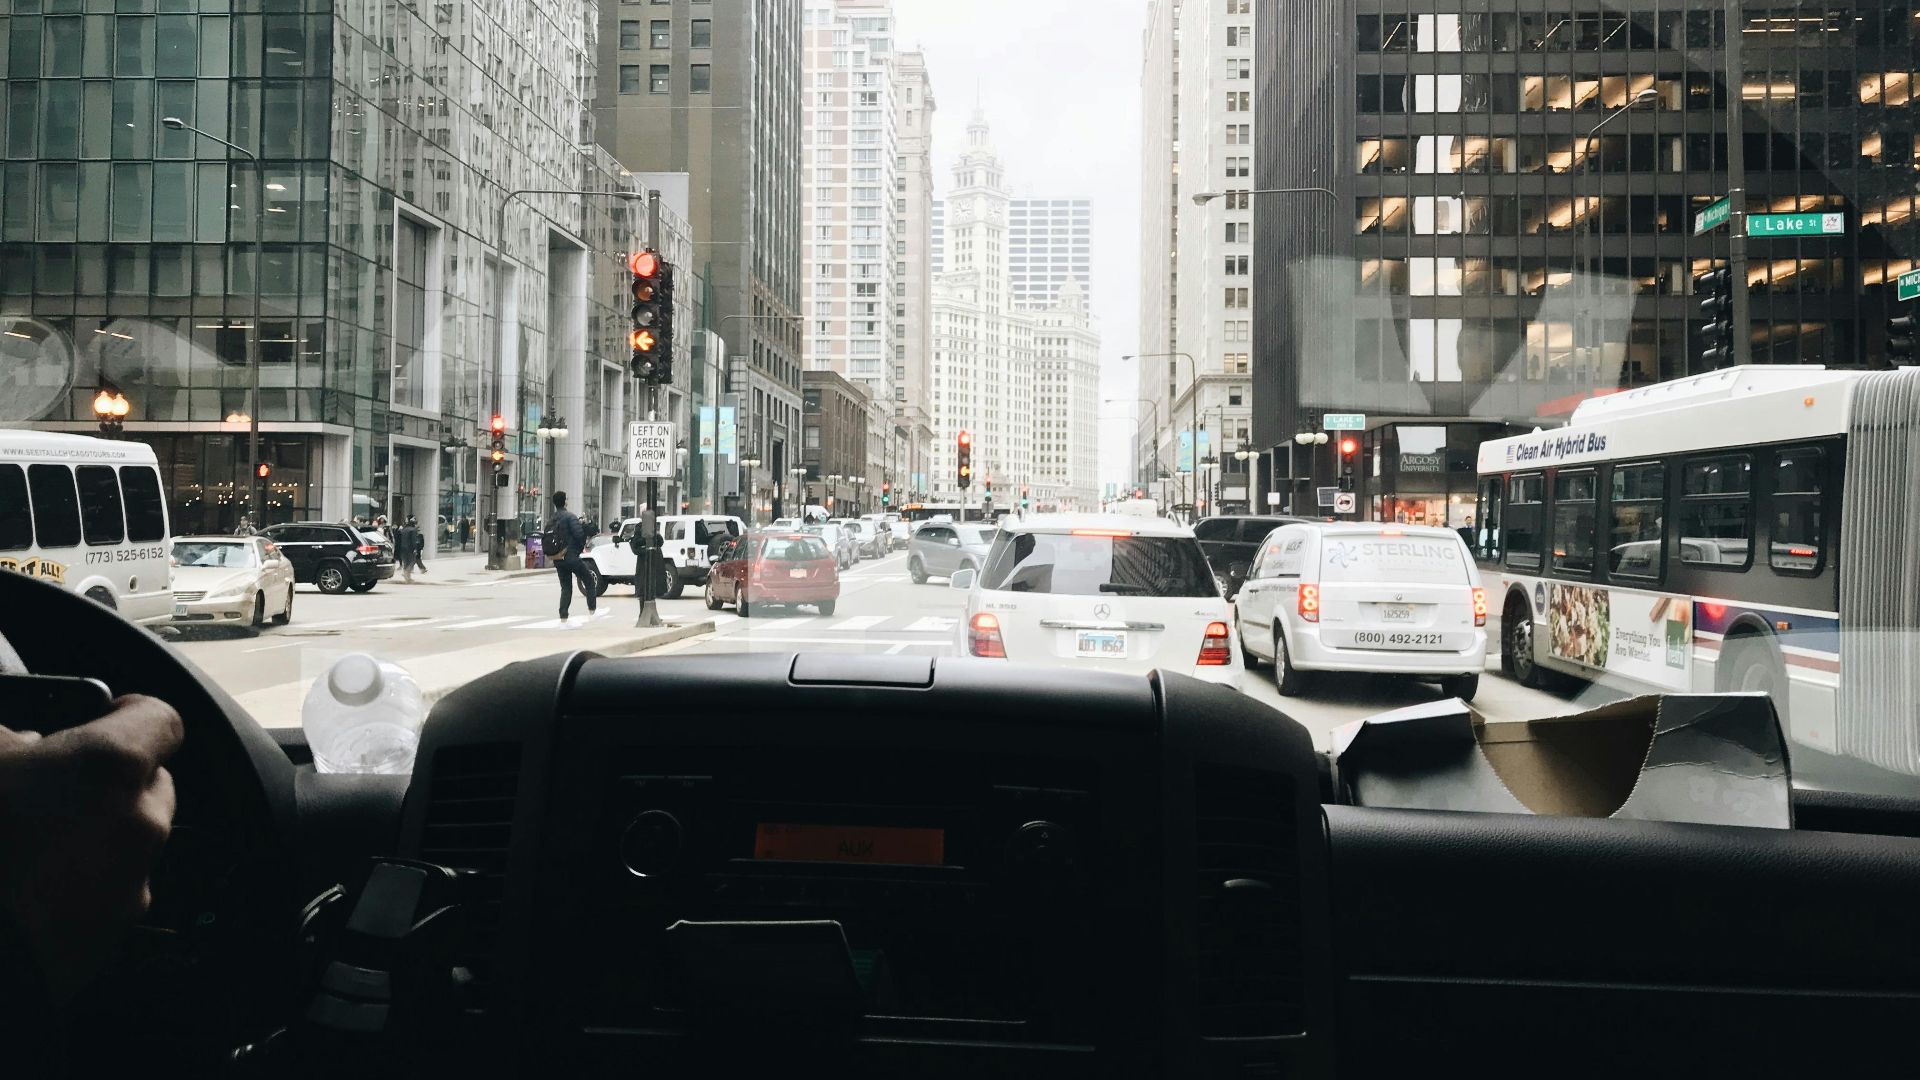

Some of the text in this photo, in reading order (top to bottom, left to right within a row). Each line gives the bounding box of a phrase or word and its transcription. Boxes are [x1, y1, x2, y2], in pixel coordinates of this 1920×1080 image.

[1765, 217, 1803, 231] Lake
[1808, 219, 1817, 227] St
[632, 426, 669, 436] LEFT ON
[636, 438, 665, 448] GREEN
[1516, 432, 1607, 461] Clean Air Hybrid Bus
[635, 450, 666, 460] ARROW
[1400, 455, 1441, 464] ARGOSY
[639, 462, 662, 472] ONLY
[1400, 464, 1440, 472] UNIVERSITY
[85, 547, 164, 565] (773) 525-6152
[1362, 543, 1456, 560] STERLING
[40, 562, 61, 578] ALL!
[1354, 632, 1443, 644] (800) 492-2121
[1615, 627, 1661, 648] Everything You
[837, 839, 874, 857] AUX
